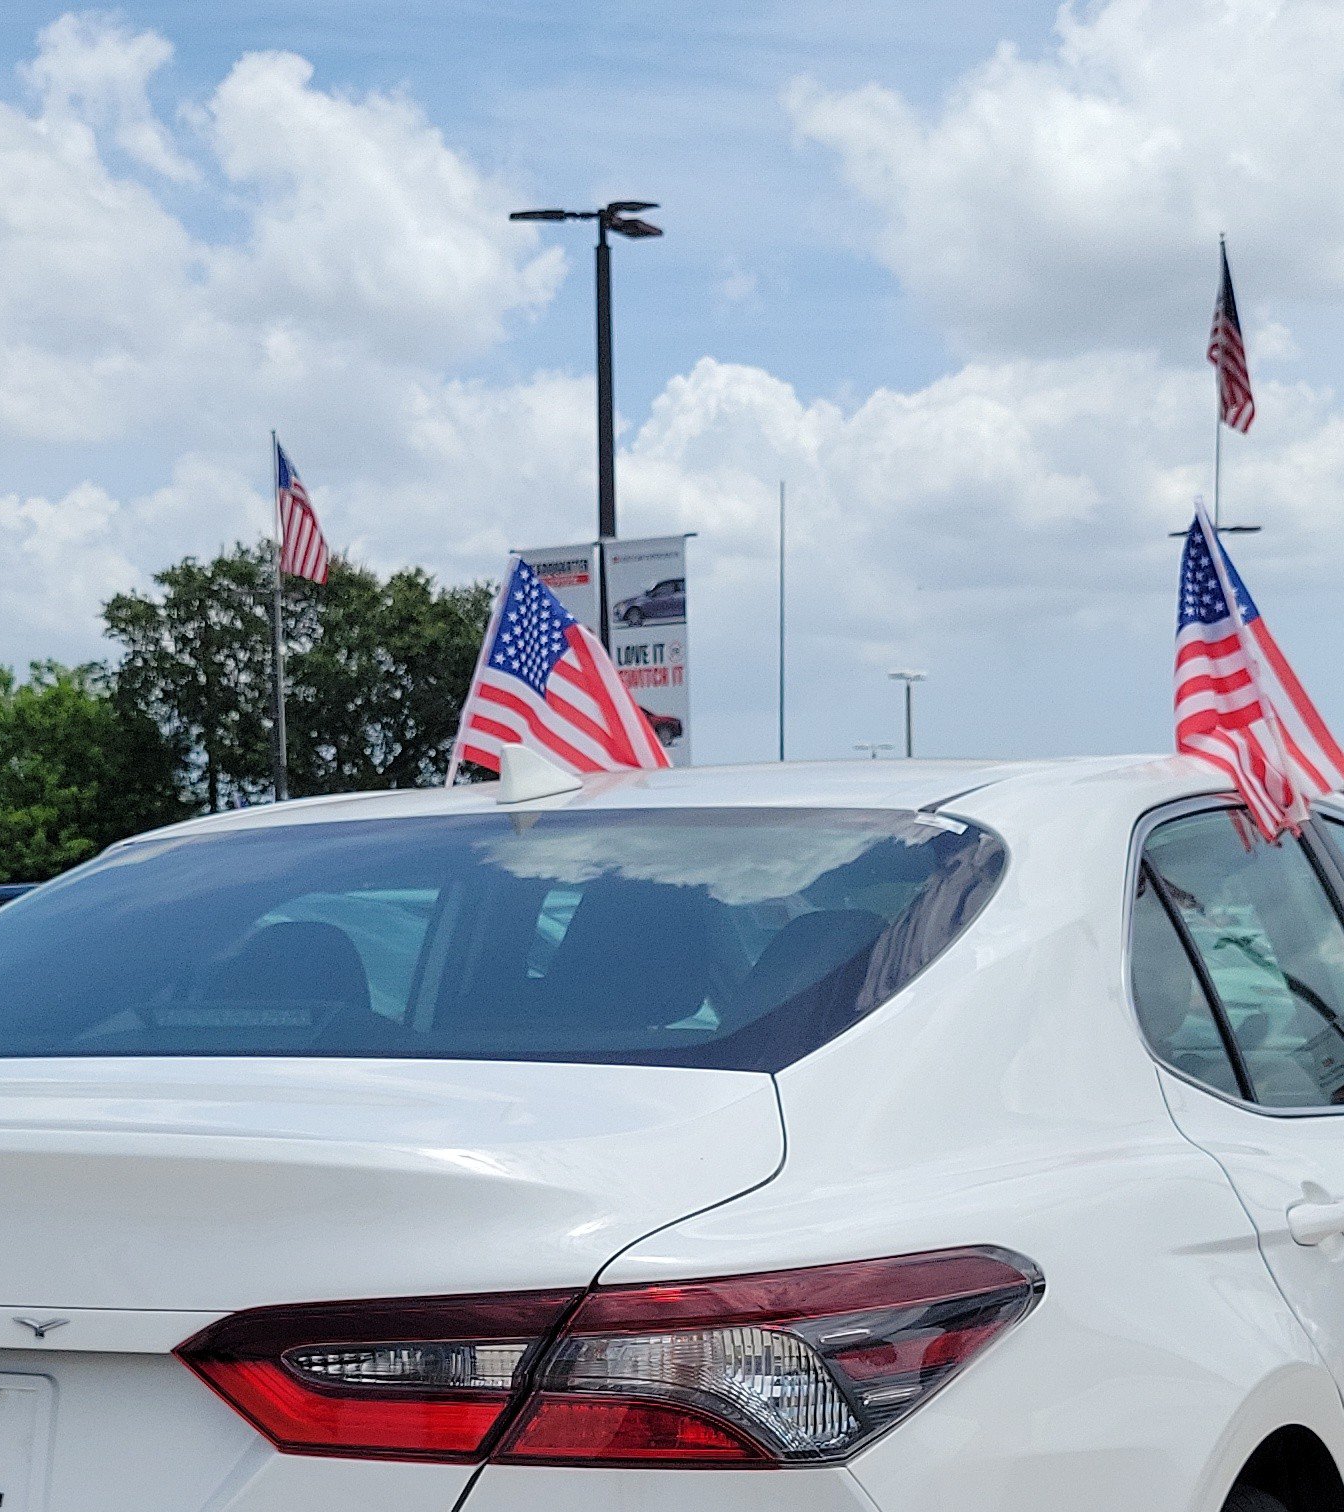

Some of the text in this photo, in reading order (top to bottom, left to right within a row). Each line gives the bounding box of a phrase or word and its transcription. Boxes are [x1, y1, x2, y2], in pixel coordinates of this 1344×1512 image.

[616, 643, 666, 667] LOVE IT
[672, 665, 684, 686] IT
